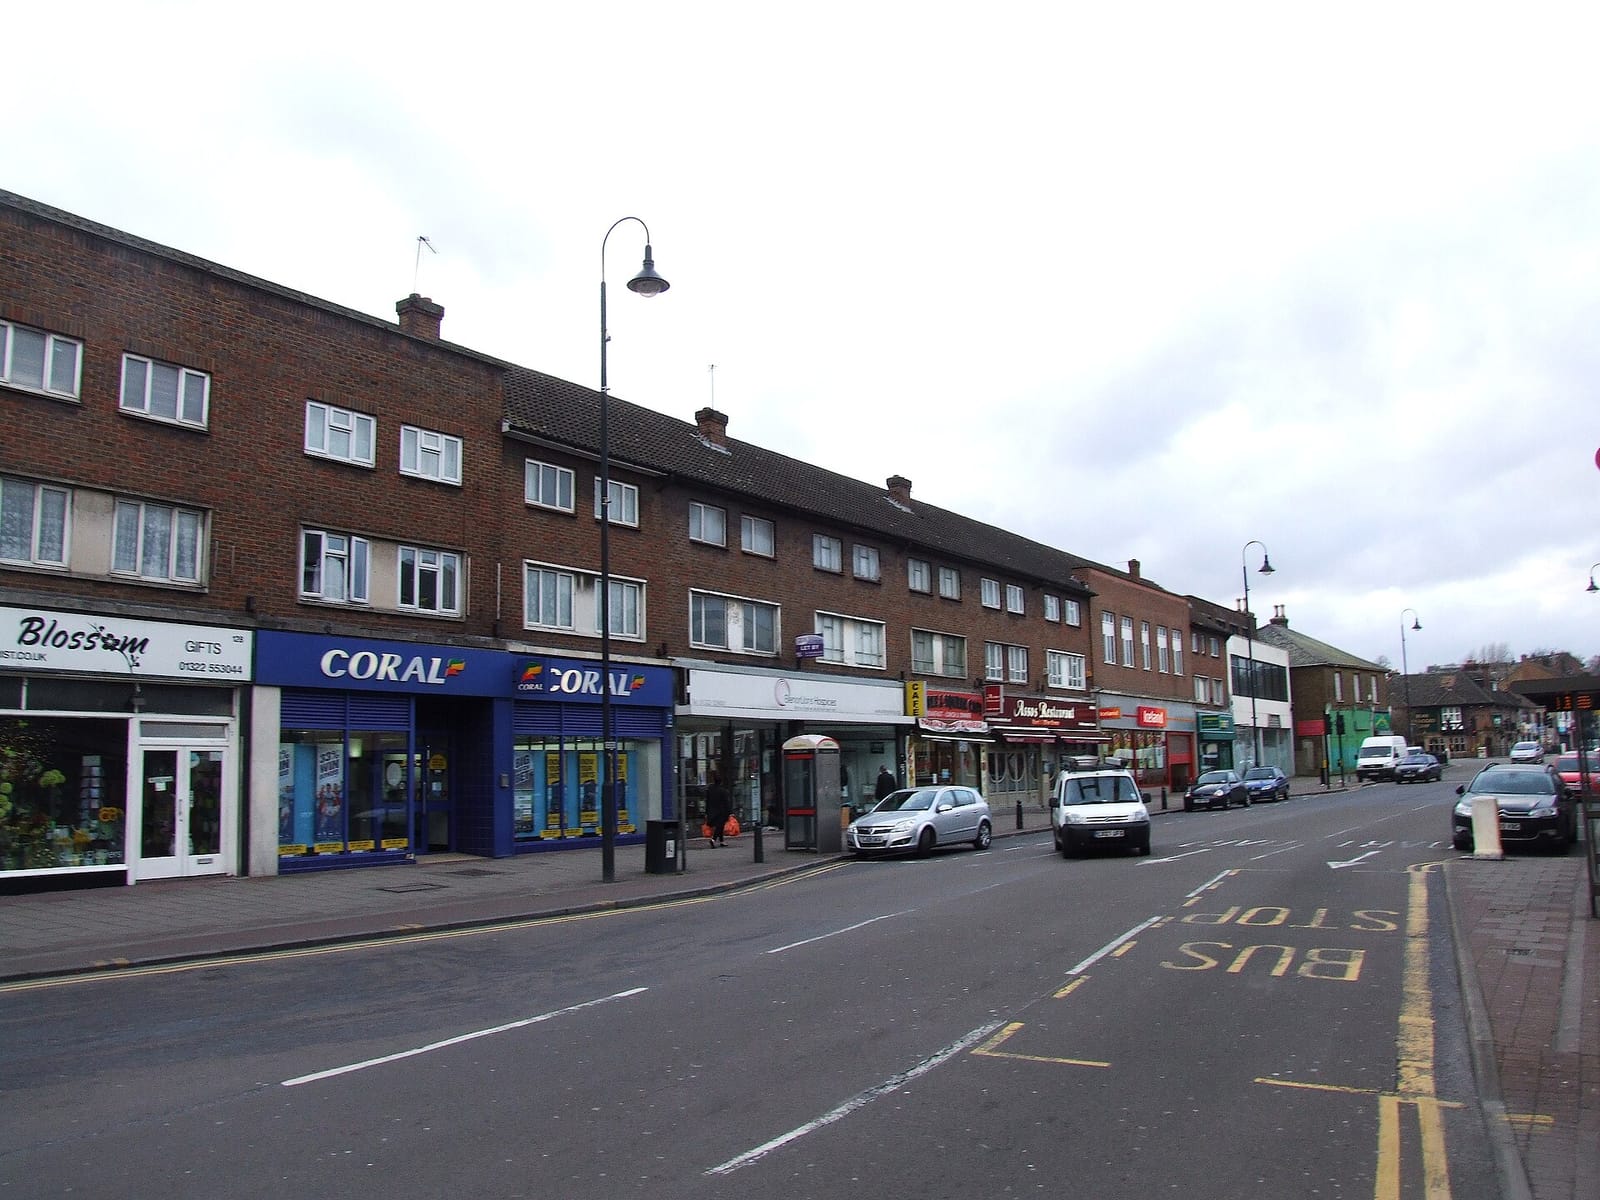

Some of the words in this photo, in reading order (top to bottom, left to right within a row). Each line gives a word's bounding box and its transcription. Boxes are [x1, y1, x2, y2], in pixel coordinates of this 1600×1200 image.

[18, 616, 150, 654] Blossom
[185, 640, 222, 654] GIFTS
[179, 661, 207, 673] 01322
[208, 663, 243, 674] 553044
[320, 649, 446, 684] CORAL
[518, 683, 543, 691] CORAL
[911, 683, 919, 716] CAFE
[1181, 905, 1400, 931] STOP
[1159, 941, 1366, 981] BUS
